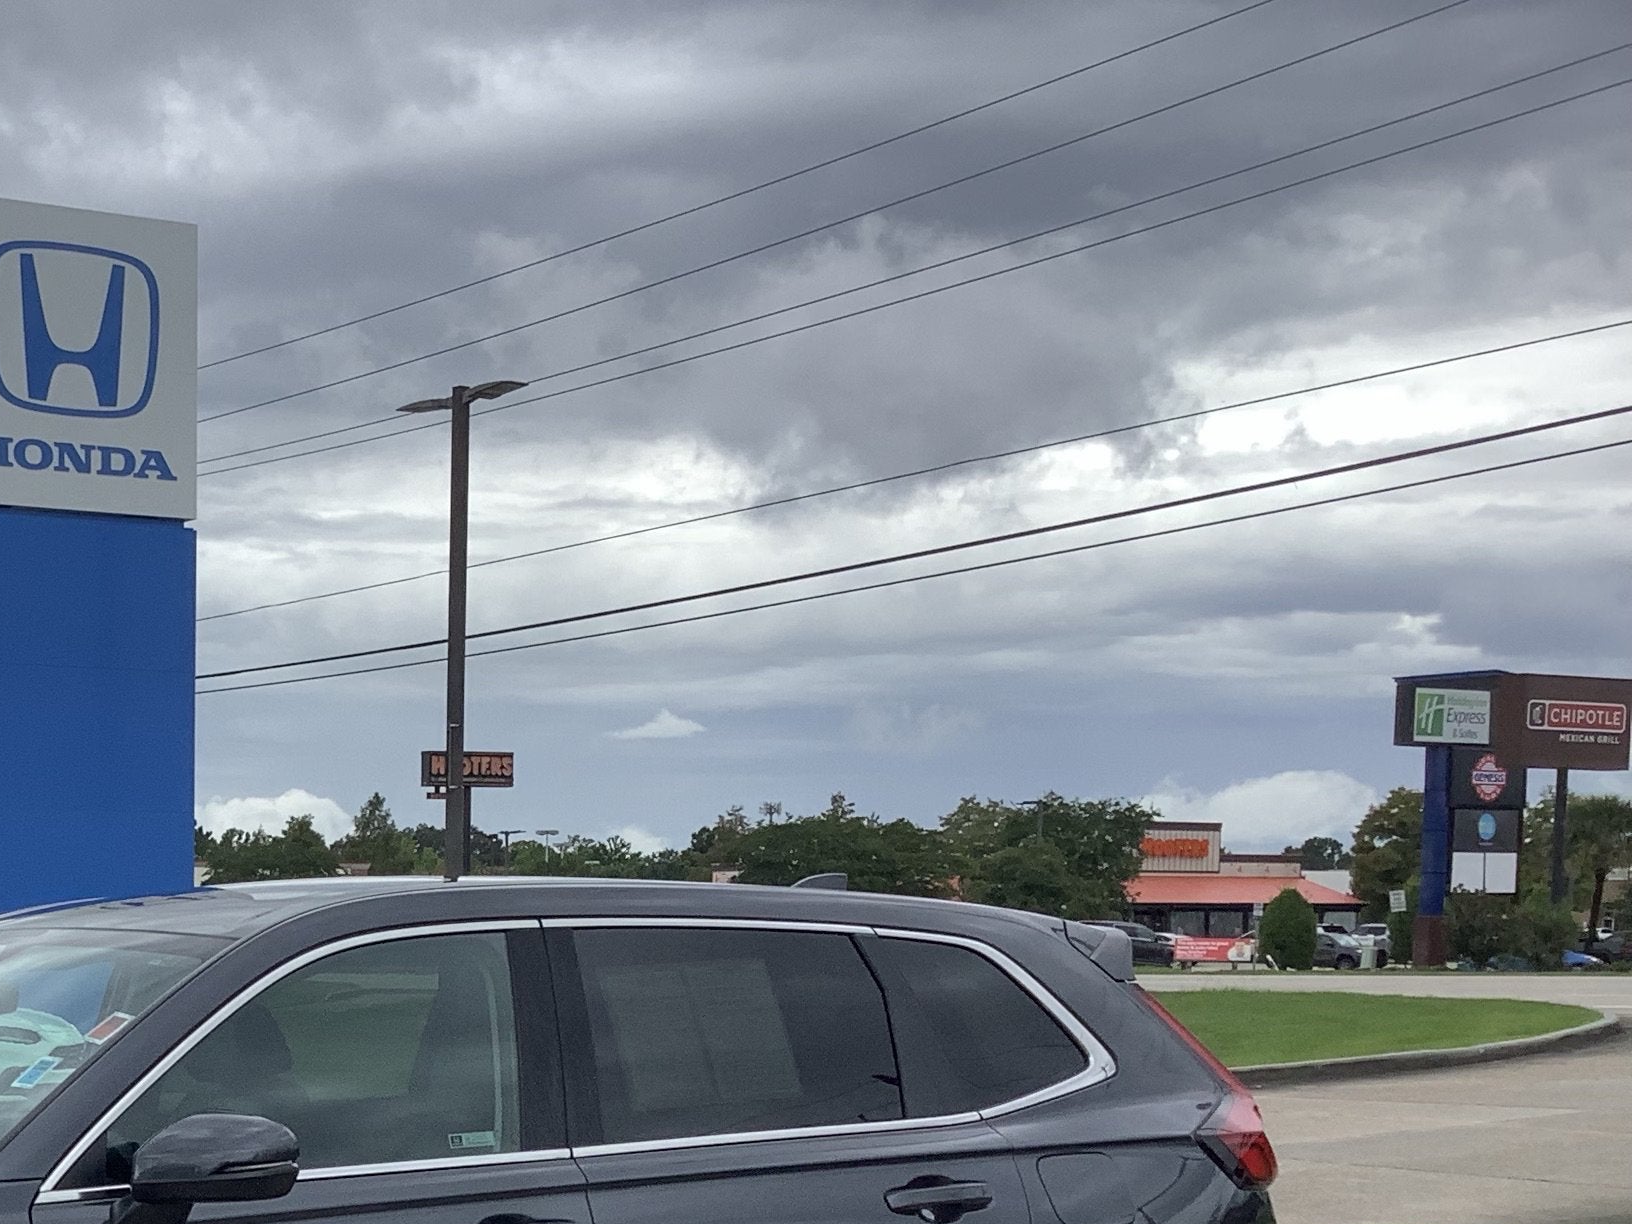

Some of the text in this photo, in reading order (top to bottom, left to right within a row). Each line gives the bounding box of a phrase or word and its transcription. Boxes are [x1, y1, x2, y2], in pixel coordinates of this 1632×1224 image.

[1447, 707, 1487, 727] Express
[1550, 707, 1622, 726] CHIPOTLE
[1559, 733, 1595, 743] MEXICAN
[431, 755, 513, 776] HOTERS
